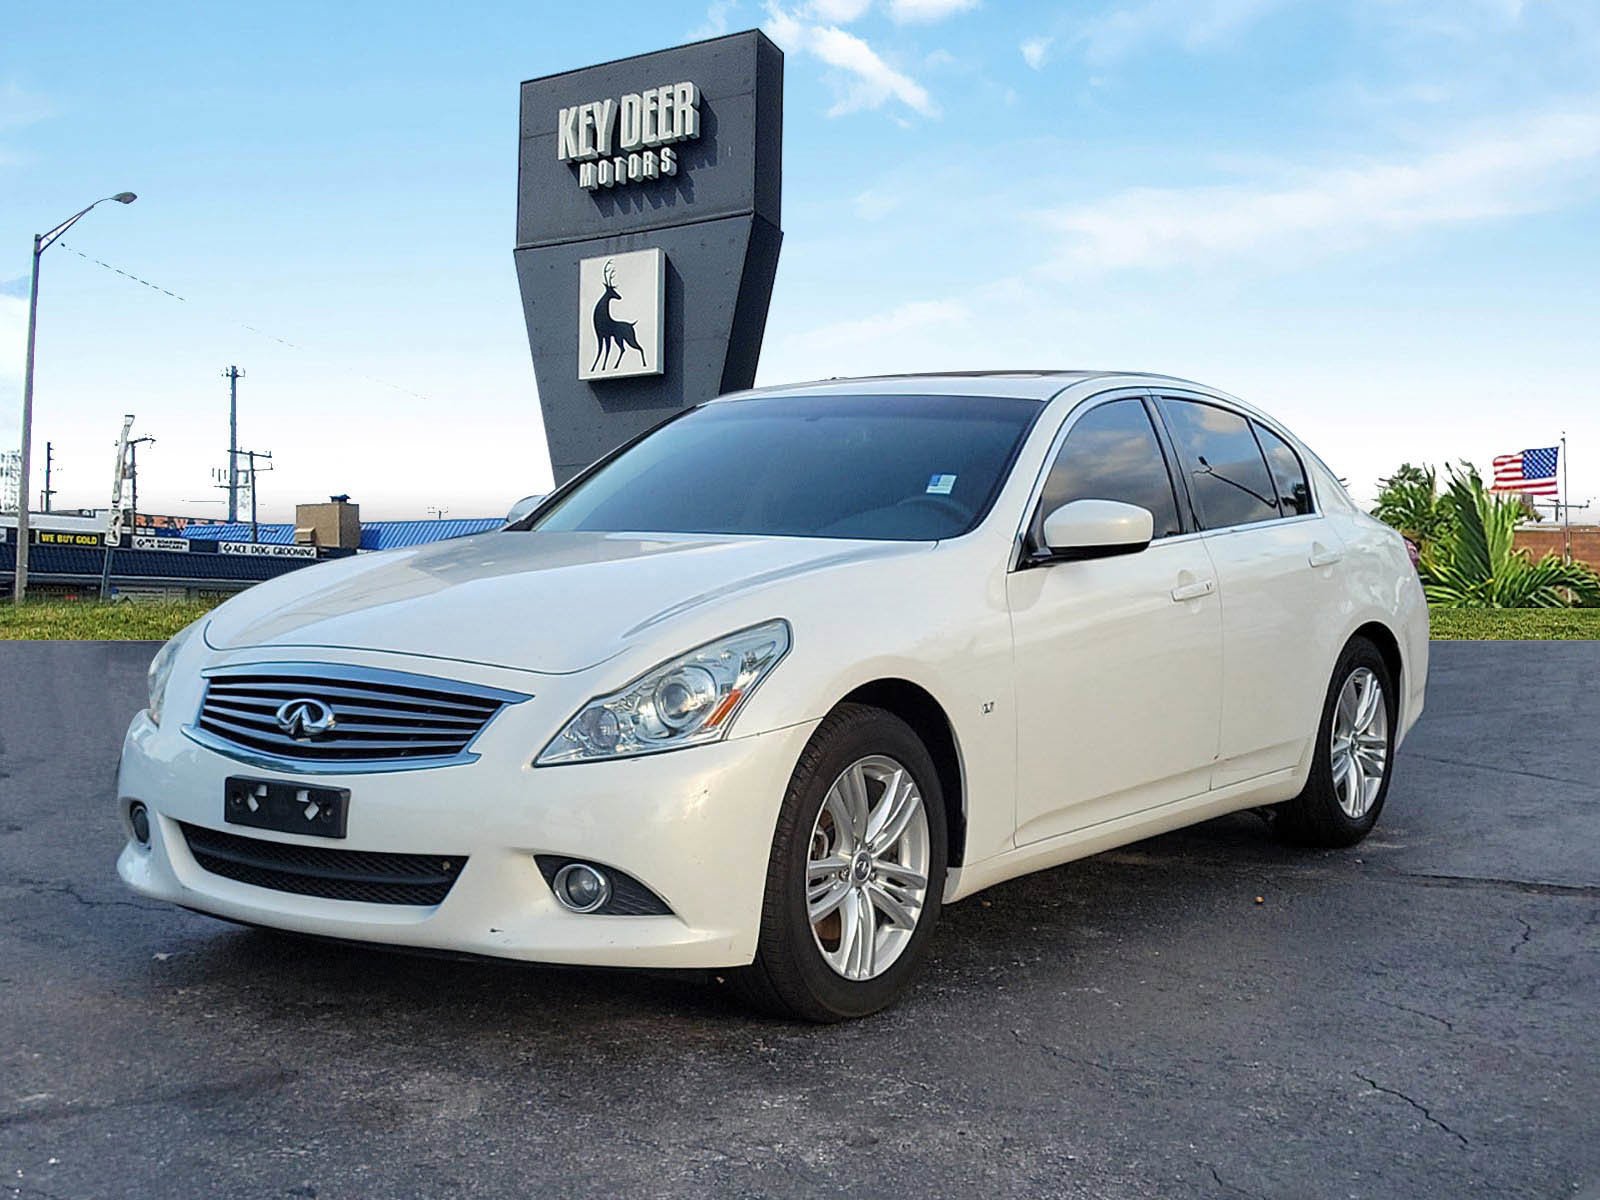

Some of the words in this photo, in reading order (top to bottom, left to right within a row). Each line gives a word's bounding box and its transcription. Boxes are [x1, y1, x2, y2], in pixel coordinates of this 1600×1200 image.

[558, 98, 618, 161] KEY
[621, 81, 700, 151] DEER
[579, 147, 677, 190] MOTORS
[41, 533, 55, 543] WE
[57, 534, 75, 544] BUY
[76, 535, 97, 545] GOLD
[233, 544, 246, 553] ACE
[251, 545, 270, 555] DOG
[273, 546, 314, 557] GROOMING
